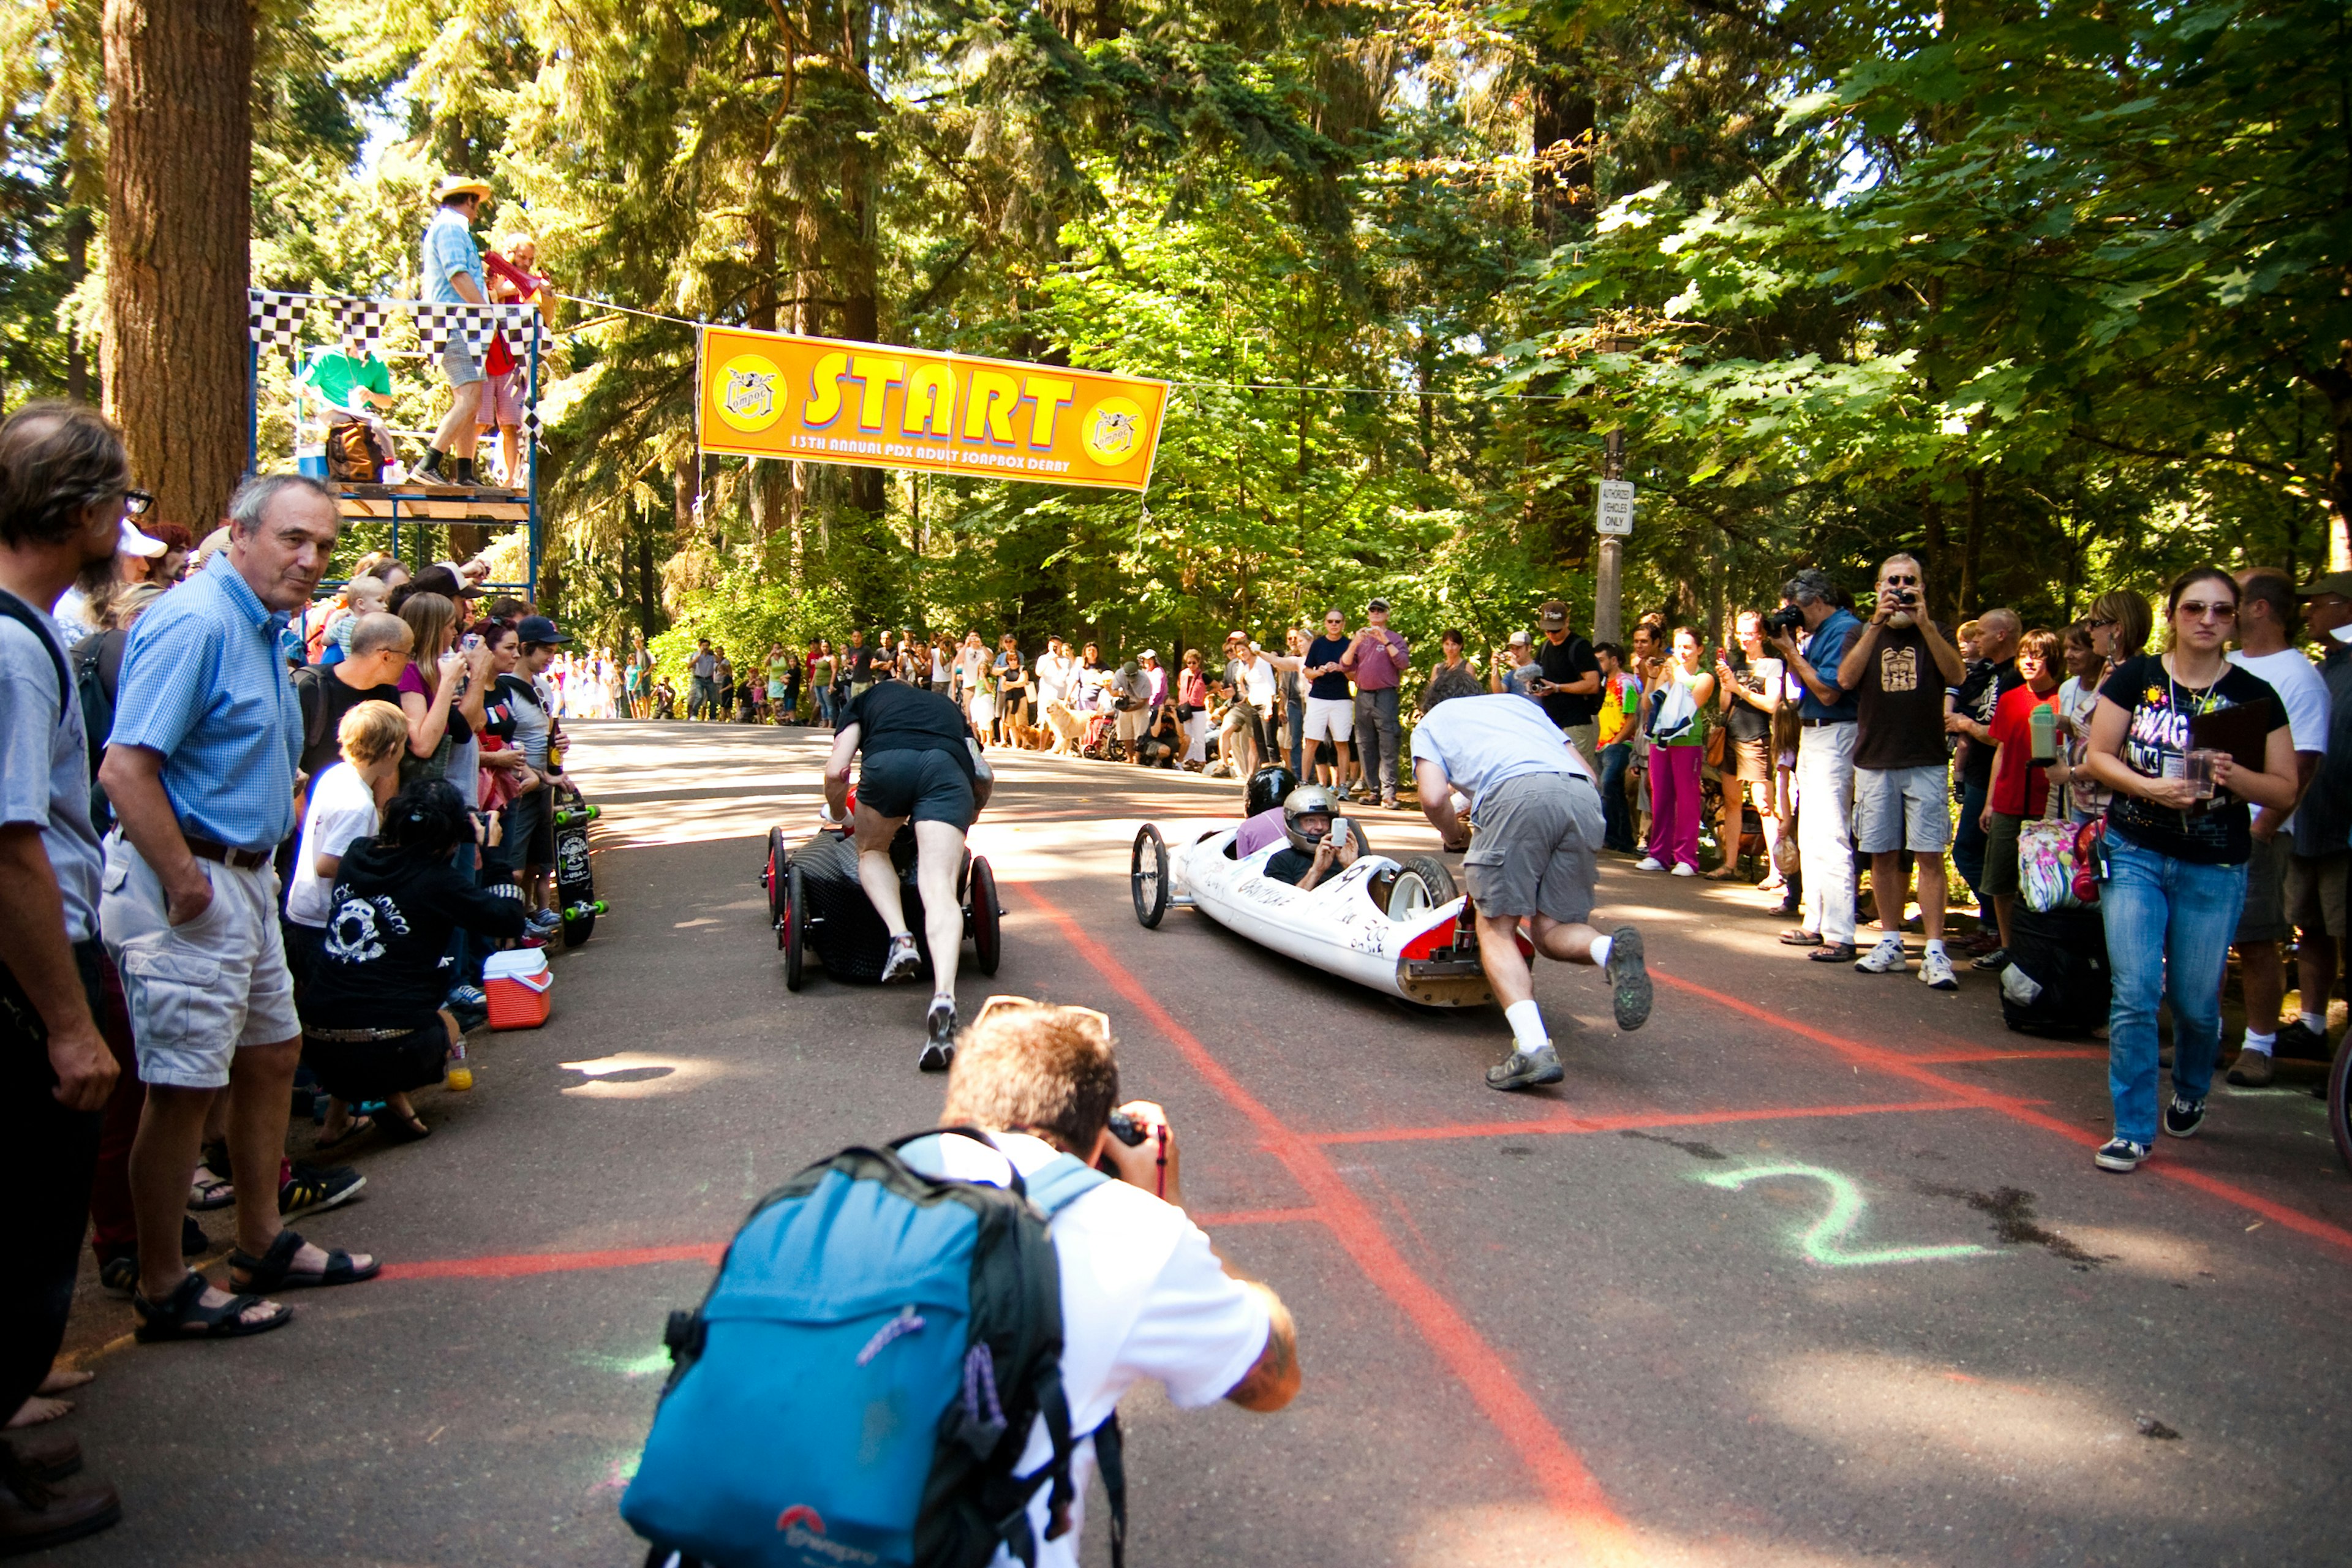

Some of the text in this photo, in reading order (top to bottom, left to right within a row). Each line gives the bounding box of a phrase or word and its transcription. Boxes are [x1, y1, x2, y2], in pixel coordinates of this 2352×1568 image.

[802, 352, 1076, 451] START
[791, 435, 1070, 473] 13TH ANNUAL PDX ADULT SOAPBOX DERBY
[1603, 489, 1630, 499] AUTHORIZED
[1604, 503, 1627, 513] VEHICLES
[1605, 516, 1624, 527] ONLY
[1691, 1161, 2000, 1267] 2
